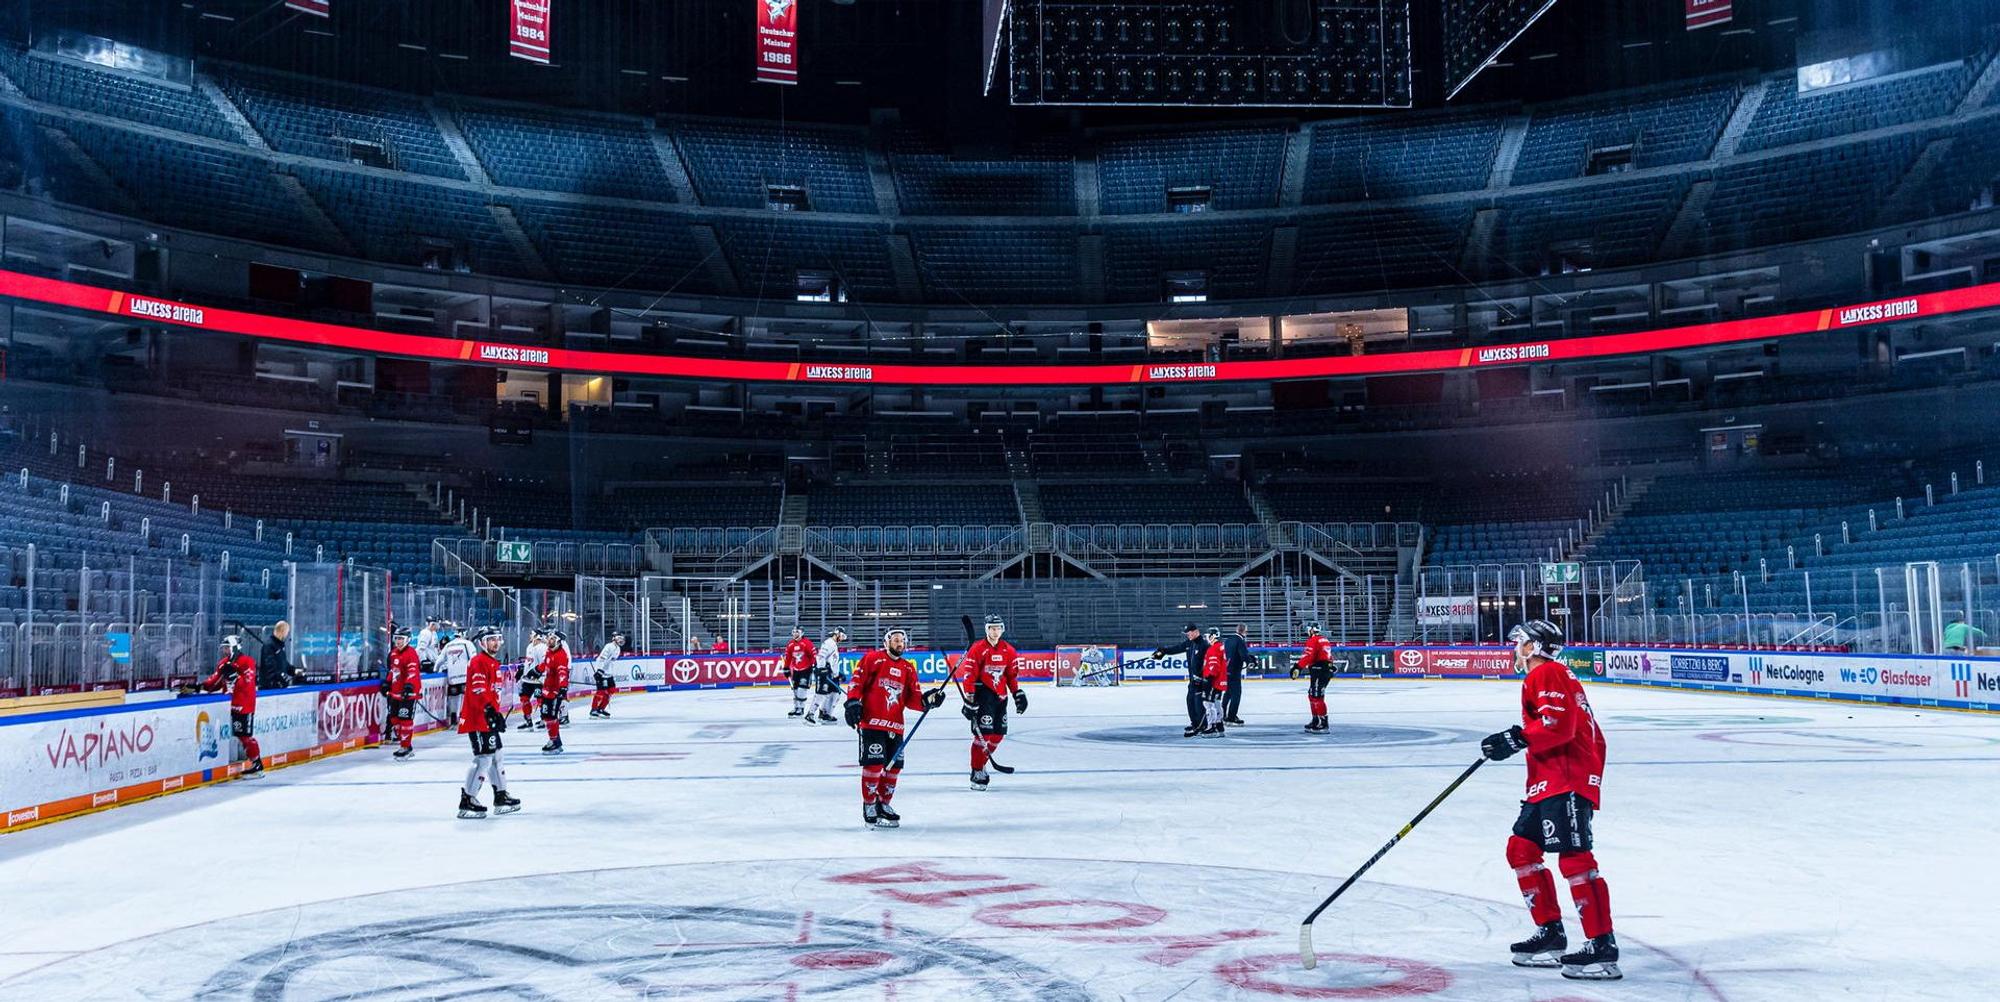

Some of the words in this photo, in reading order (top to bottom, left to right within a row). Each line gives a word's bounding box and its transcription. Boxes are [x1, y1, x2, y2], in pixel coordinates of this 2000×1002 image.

[517, 25, 545, 41] 1984
[760, 26, 795, 37] Deutscher
[763, 38, 791, 48] Meister
[763, 51, 792, 64] 1986
[131, 298, 172, 319] LANXESS
[173, 305, 203, 324] arena
[1840, 306, 1882, 324] LANXESS
[1884, 299, 1918, 318] arena
[480, 345, 519, 361] LANXESS
[520, 349, 549, 363] arena
[1479, 348, 1520, 362] LANXESS
[1519, 344, 1549, 359] arena
[806, 366, 842, 378] LANXESS
[844, 367, 872, 379] arena
[1150, 367, 1187, 379] LANXESS
[1187, 365, 1216, 378] arena
[1417, 604, 1450, 617] LNXESS
[703, 660, 785, 679] TOYOTA
[1017, 657, 1071, 673] Energie
[1608, 655, 1639, 671] JONAS
[1766, 664, 1825, 686] NetCologne
[1840, 668, 1857, 683] We
[1880, 669, 1932, 687] Glasfaser
[347, 692, 385, 730] TOYO
